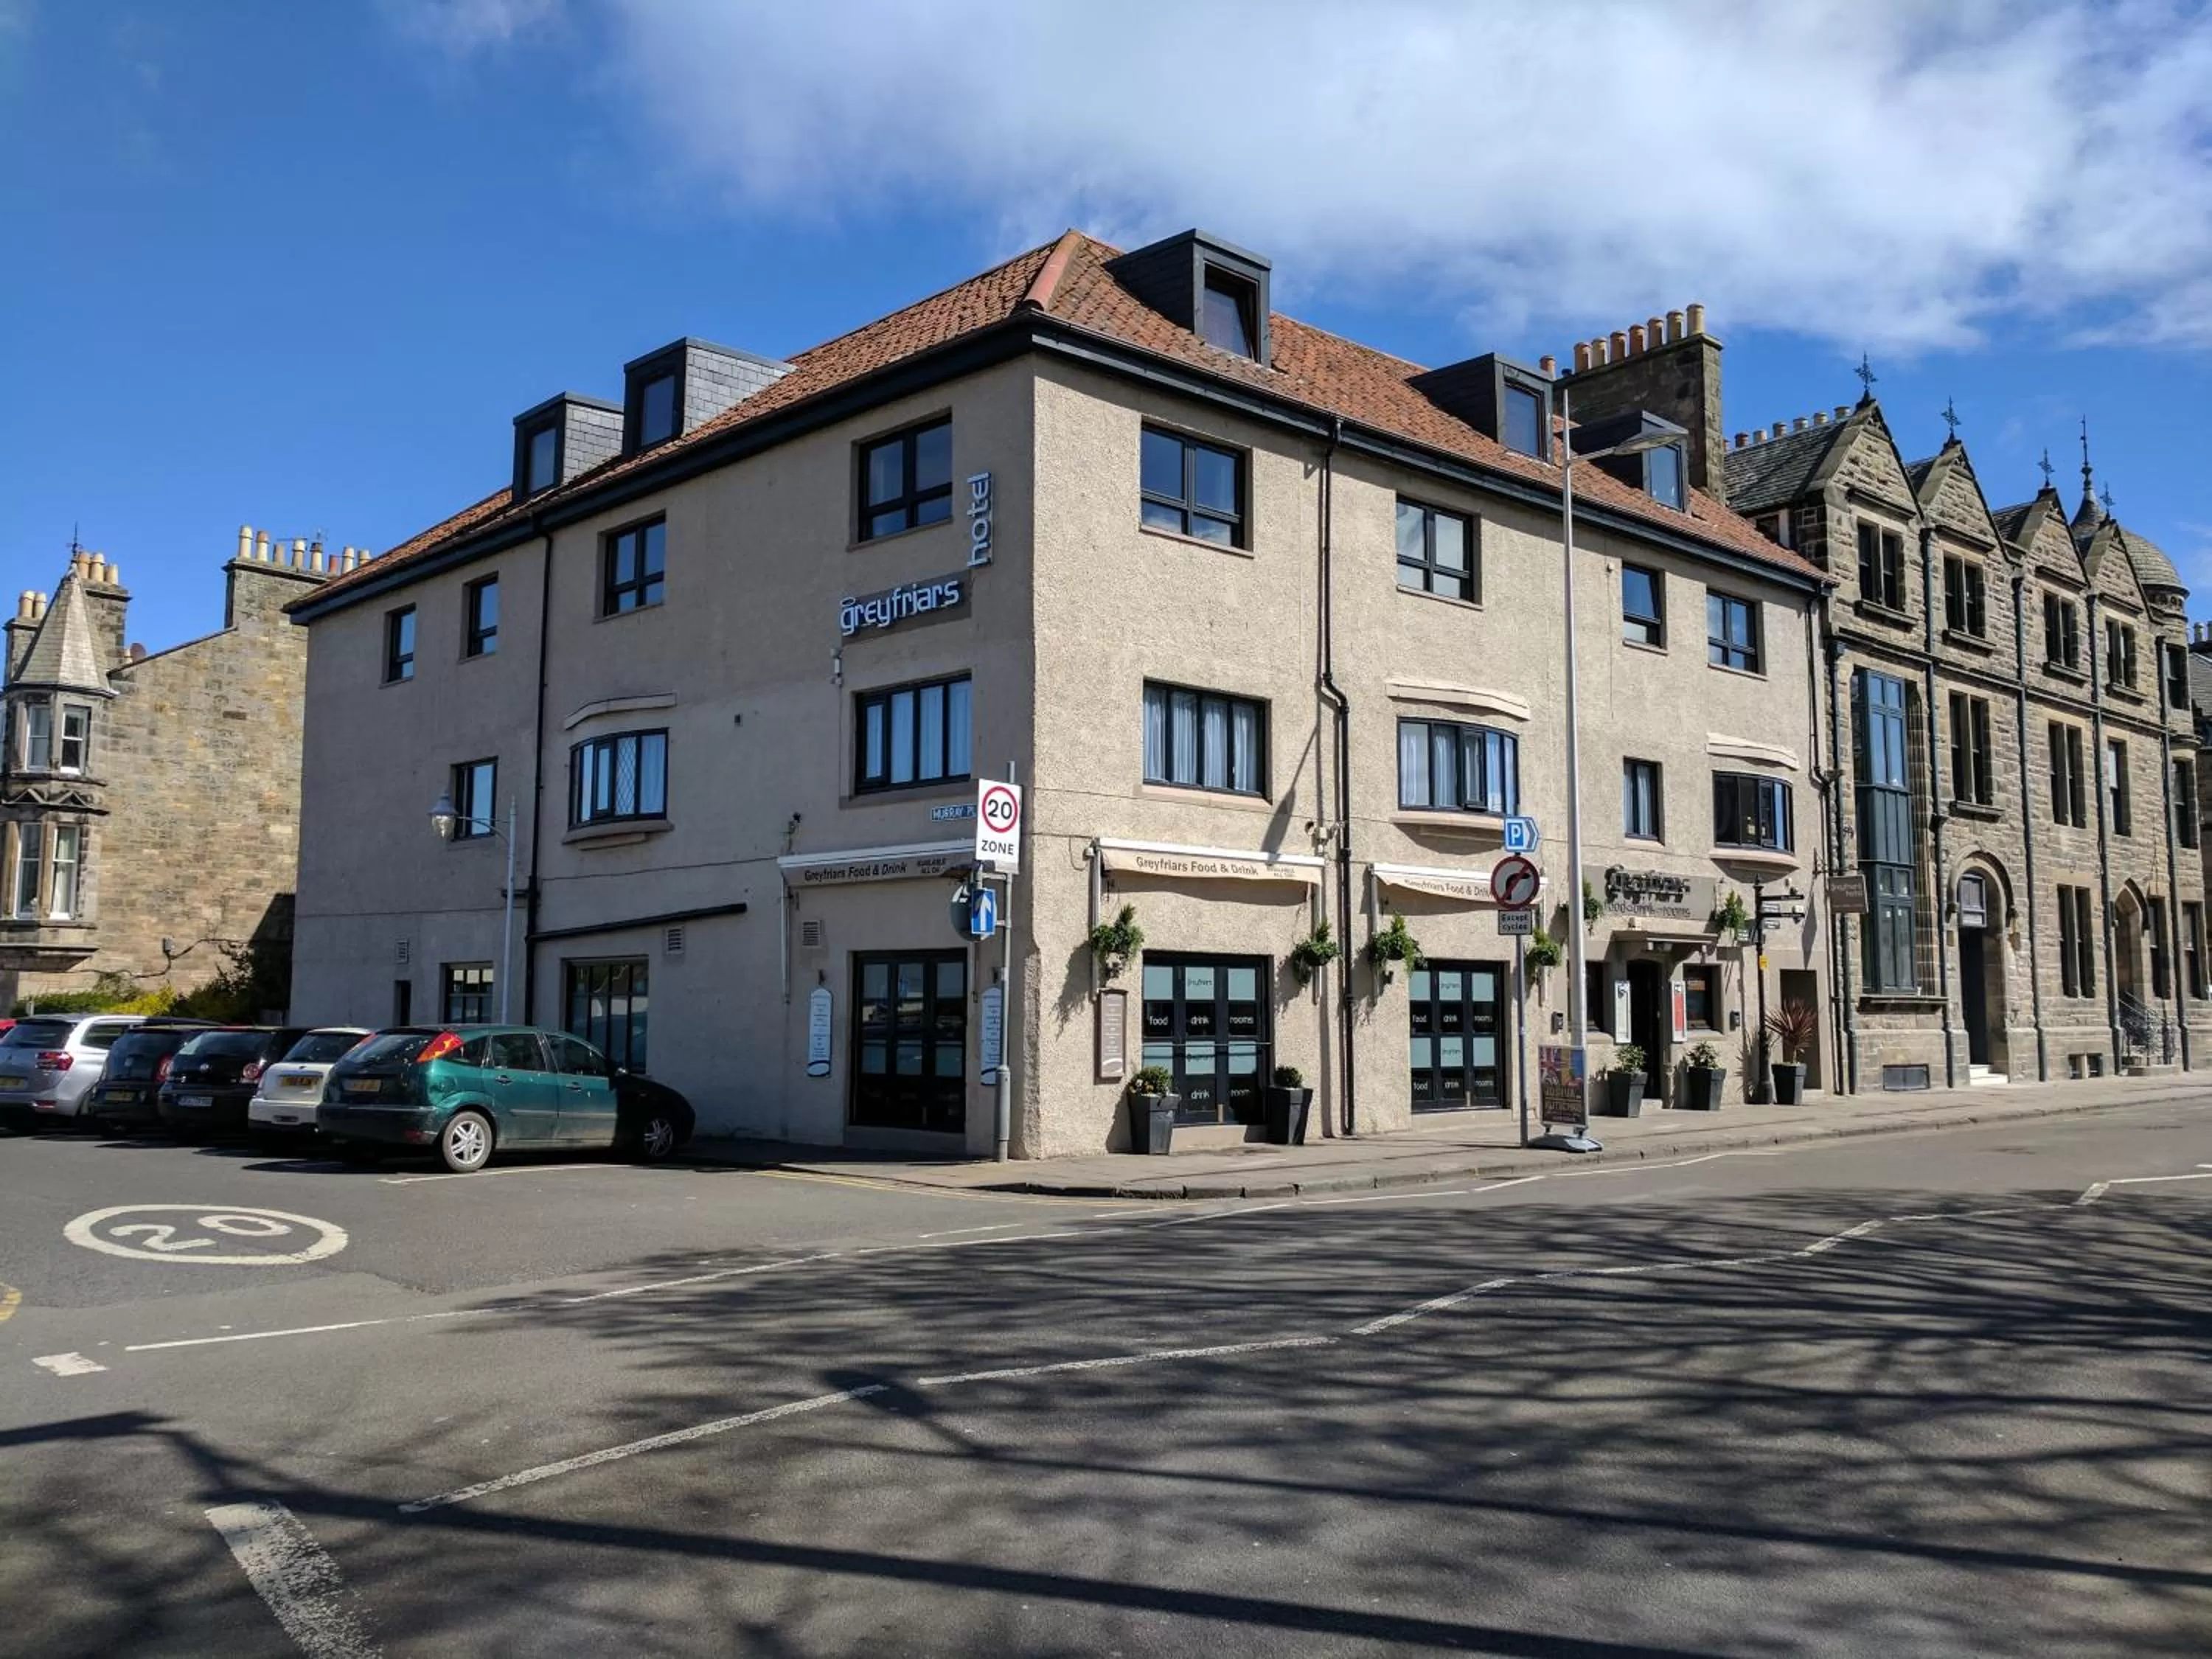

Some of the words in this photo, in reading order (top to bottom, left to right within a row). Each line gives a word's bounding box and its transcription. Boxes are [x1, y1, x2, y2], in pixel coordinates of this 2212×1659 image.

[967, 472, 991, 567] hotel
[840, 580, 960, 636] greyfriars
[932, 805, 962, 820] MURRAY
[987, 799, 1012, 820] 20
[1512, 825, 1521, 844] P
[981, 840, 1015, 855] ZONE
[804, 866, 846, 882] Greyfriars
[848, 863, 871, 877] Food
[872, 864, 879, 875] &
[881, 861, 907, 874] Drink
[1136, 856, 1188, 873] Greyfriars
[1191, 860, 1217, 873] Food
[1220, 863, 1228, 873] &
[1231, 863, 1259, 876] Drink
[1501, 914, 1528, 922] Except
[1502, 923, 1528, 931] cycles
[1149, 1015, 1169, 1026] food
[1190, 1015, 1209, 1025] drink
[1229, 1016, 1253, 1025] rooms
[1412, 1014, 1427, 1023] food
[1413, 1081, 1428, 1091] food
[1190, 1089, 1210, 1099] drink
[109, 1214, 292, 1251] 20
